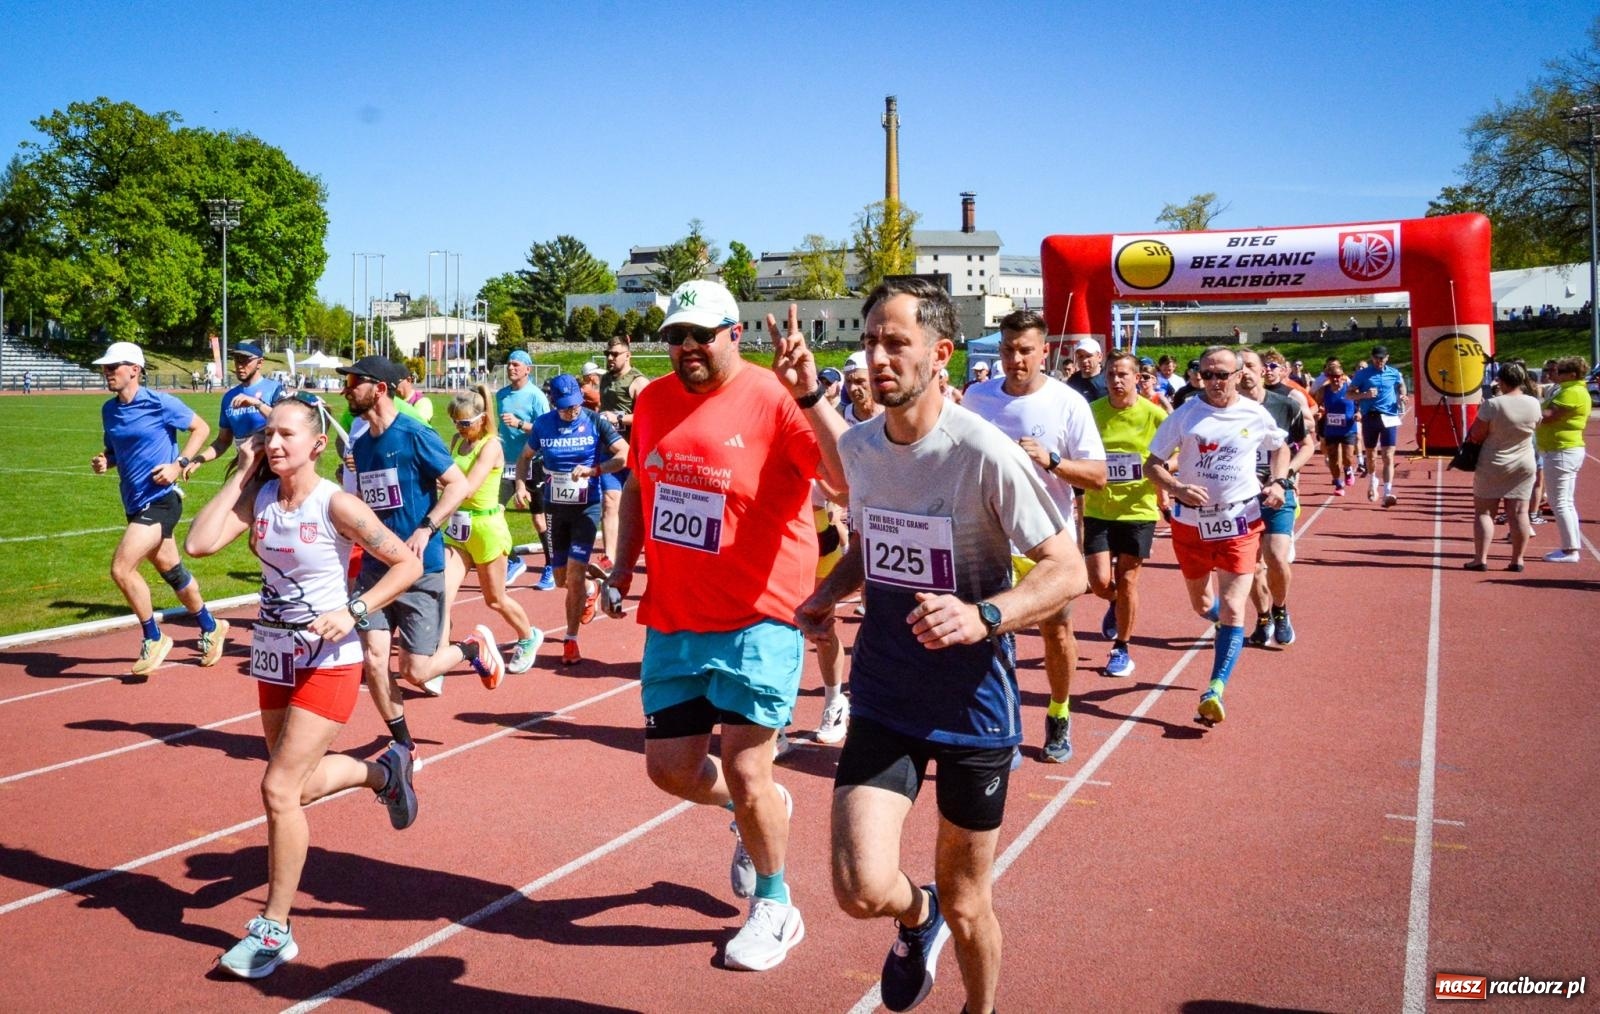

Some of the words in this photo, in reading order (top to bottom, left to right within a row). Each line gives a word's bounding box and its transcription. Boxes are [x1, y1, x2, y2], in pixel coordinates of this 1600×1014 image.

[1226, 236, 1278, 248] BIEG
[1190, 255, 1232, 270] BEZ
[1236, 251, 1316, 268] GRANIC
[1200, 271, 1306, 288] RACIBÓRZ
[539, 436, 594, 448] RUNNERS
[674, 453, 704, 463] Sanlam
[666, 463, 694, 473] CAPE
[697, 466, 732, 479] TOWN
[1108, 466, 1126, 477] 116
[666, 474, 731, 490] MARATHON
[364, 488, 386, 504] 235
[556, 488, 575, 499] 147
[660, 510, 702, 538] 200
[869, 514, 881, 522] XVIII
[882, 516, 895, 525] BIEG
[896, 518, 905, 527] BEZ
[906, 520, 929, 530] GRANIC
[1205, 520, 1232, 535] 149
[876, 542, 924, 575] 225
[254, 648, 278, 673] 230
